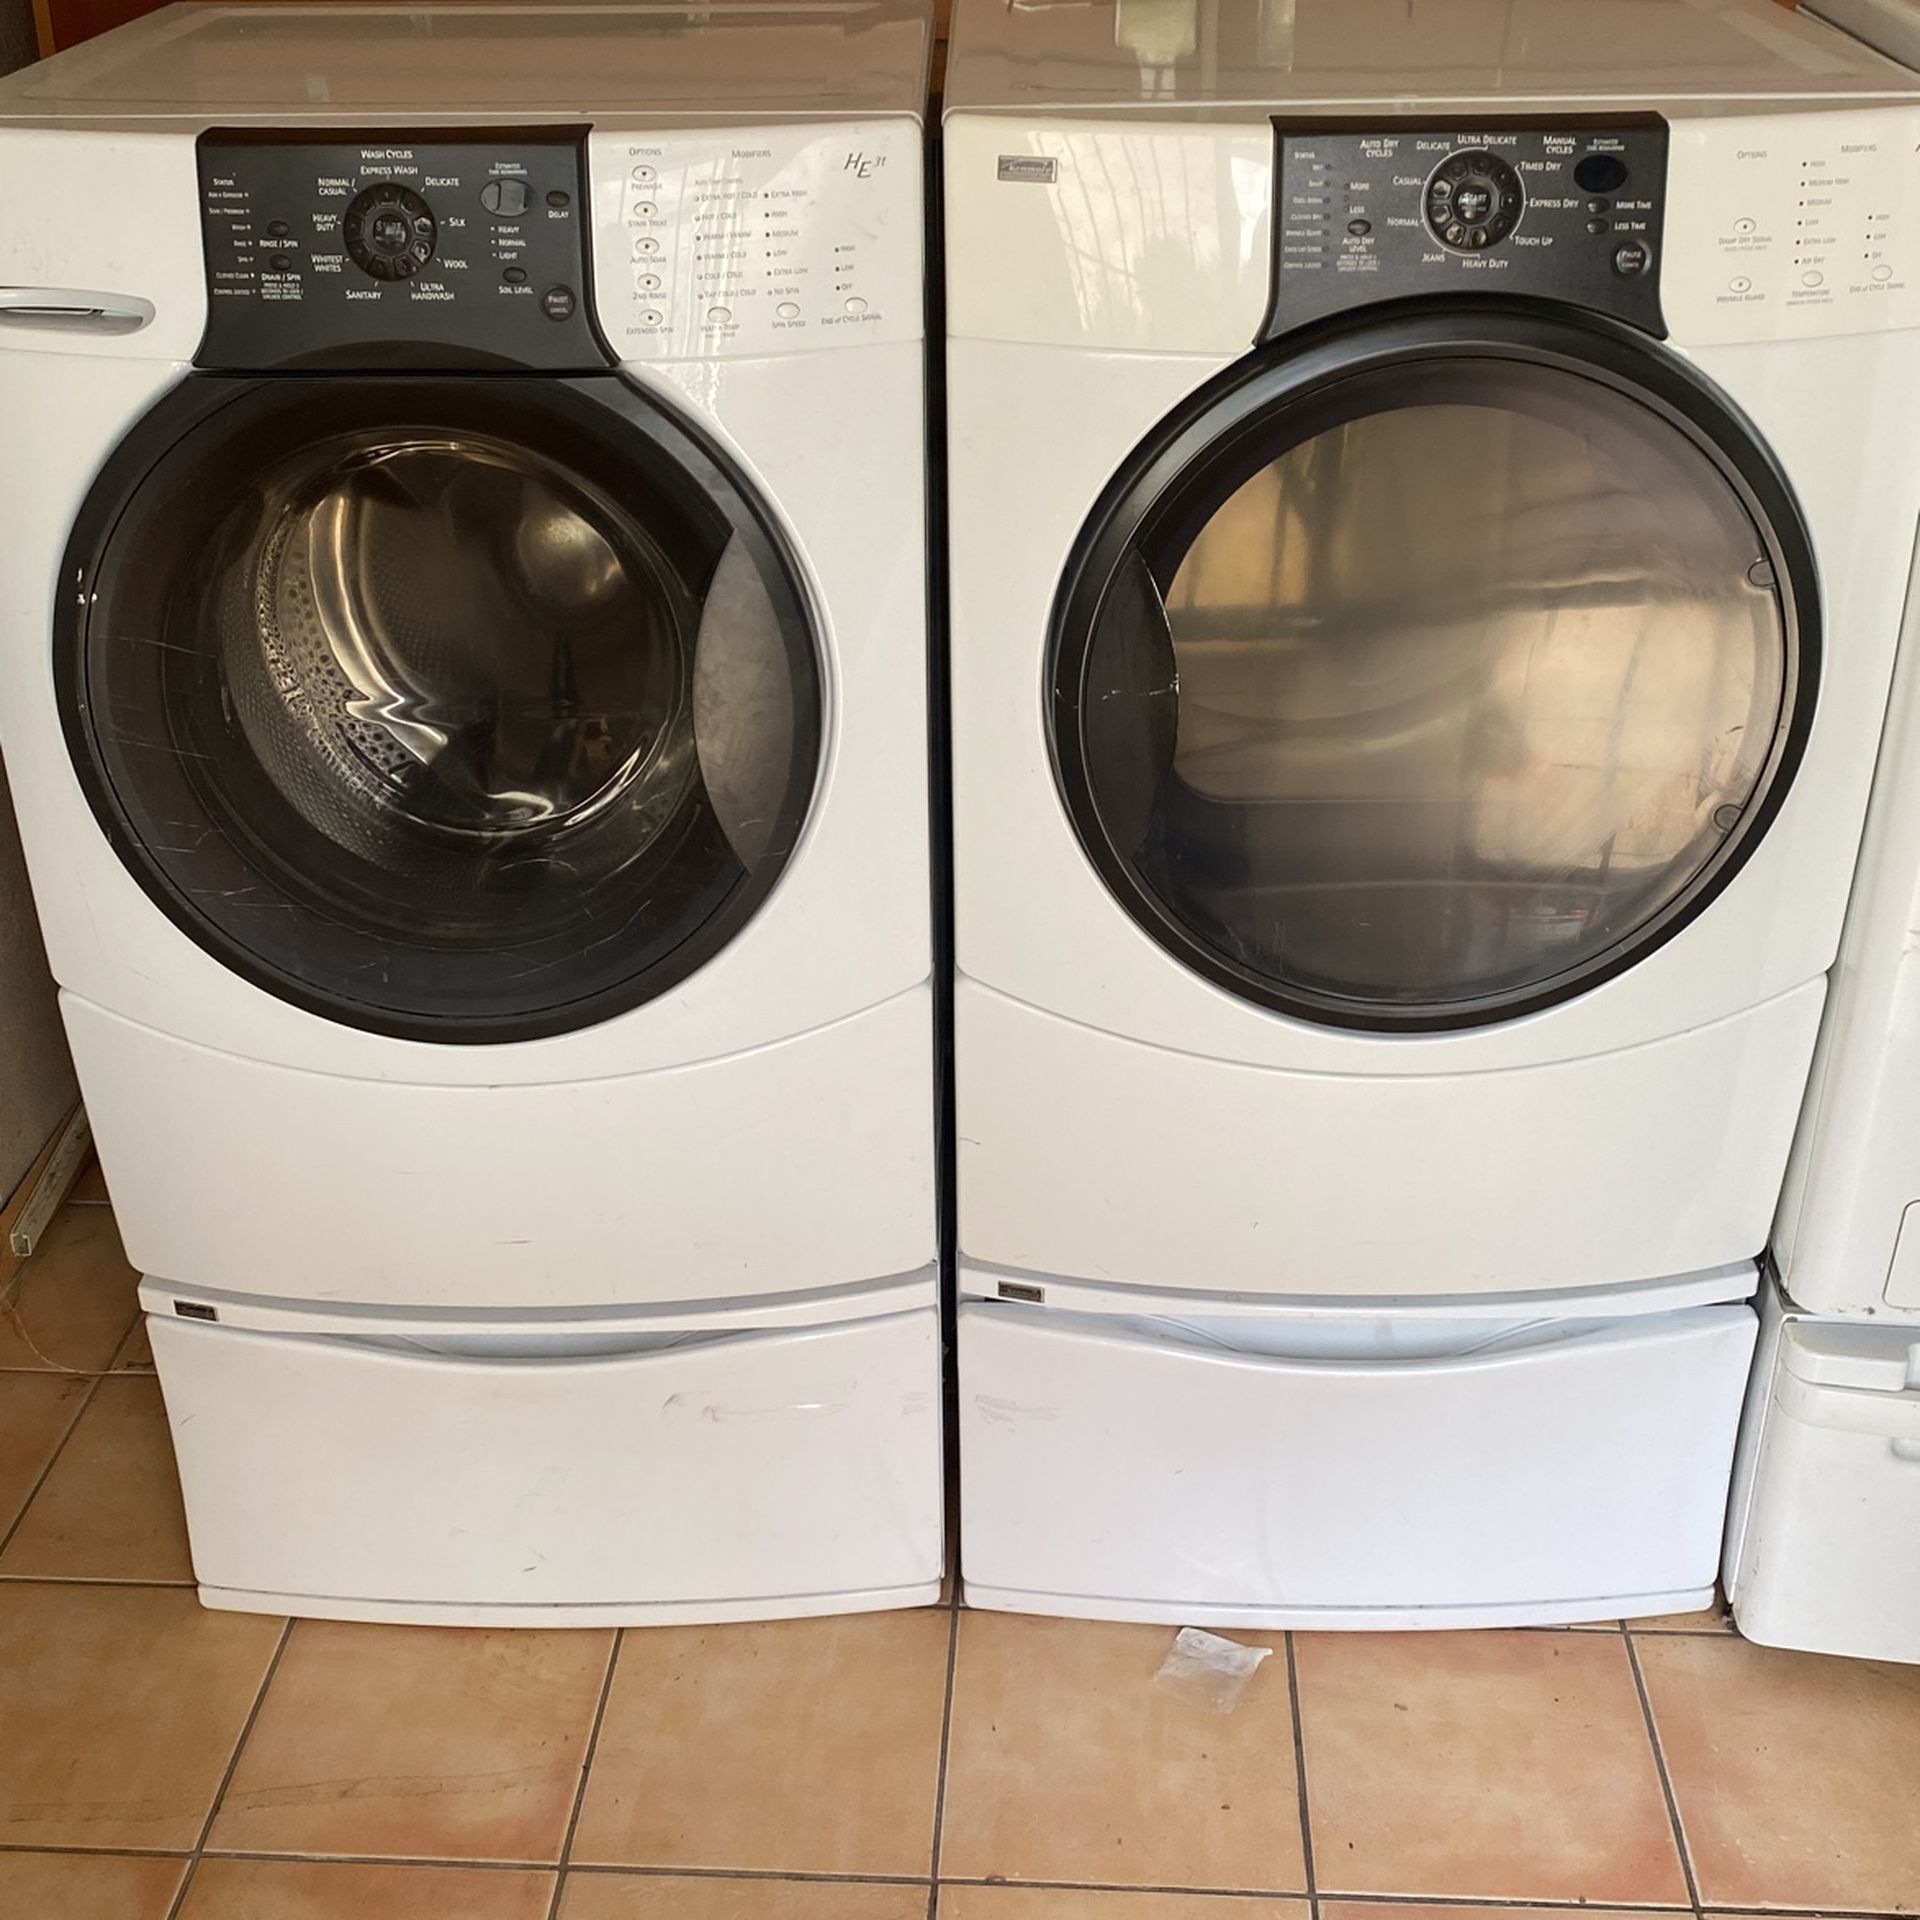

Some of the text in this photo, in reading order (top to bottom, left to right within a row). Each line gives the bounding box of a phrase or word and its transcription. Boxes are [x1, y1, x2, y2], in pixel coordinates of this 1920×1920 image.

[1360, 139, 1399, 149] AUTO DRY
[1458, 134, 1517, 145] ULTRA DELICATE
[1543, 136, 1576, 145] MANUAL
[1416, 140, 1450, 150] DELICATE
[361, 149, 413, 159] WASH CYCLES
[1366, 149, 1393, 158] CYCLES
[1546, 146, 1573, 154] CYCLES
[1520, 161, 1562, 170] TIMED DRY
[360, 166, 418, 175] EXPRESS WASH
[318, 178, 350, 187] NORMAL
[425, 177, 459, 186] DELICATE
[1392, 176, 1422, 186] CASUAL
[318, 187, 347, 196] CASUAL
[1529, 198, 1579, 208] EXPRESS DRY
[1387, 217, 1419, 226] NORMAL
[1515, 236, 1553, 246] TOUCH UP
[1422, 253, 1446, 262] JEANS
[444, 259, 468, 269] WOOL
[1463, 259, 1509, 268] HEAVY DUTY
[420, 282, 444, 291] ULTRA
[346, 289, 382, 299] SANITARY
